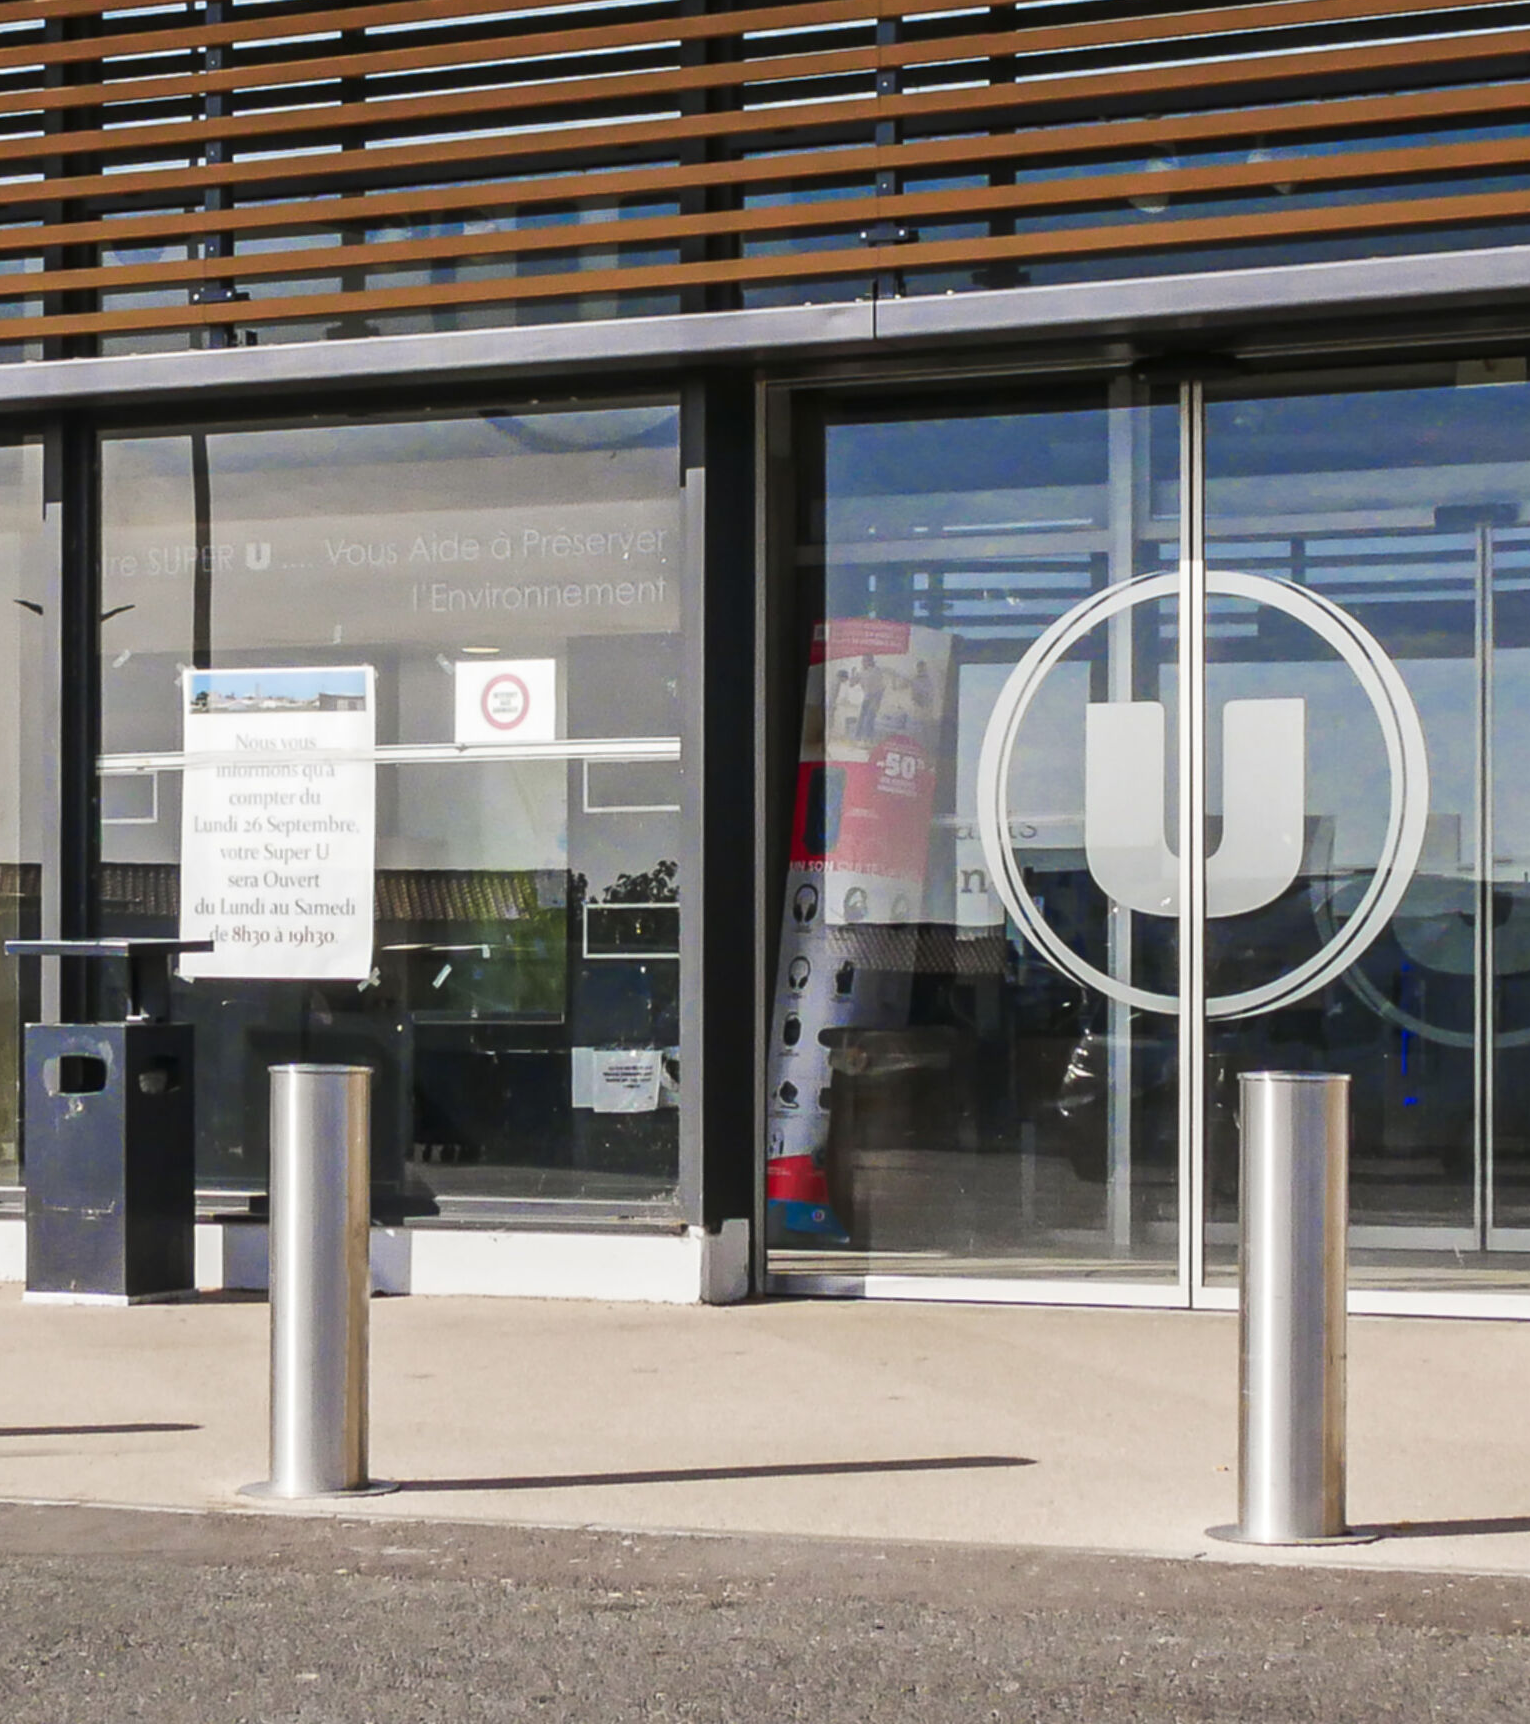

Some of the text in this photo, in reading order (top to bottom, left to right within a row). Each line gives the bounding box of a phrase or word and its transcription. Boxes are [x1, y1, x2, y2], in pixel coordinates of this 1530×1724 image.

[148, 545, 234, 575] SUPER
[245, 542, 271, 570] U
[324, 539, 398, 567] Vous
[409, 534, 479, 562] Aide
[490, 531, 511, 560] à
[523, 526, 667, 557] Préserver
[413, 577, 666, 613] l'Environnement
[235, 733, 317, 750] Nous vous
[216, 762, 298, 778] informons
[228, 787, 321, 810] compter du
[1085, 698, 1305, 918] U
[194, 815, 238, 833] Lundi
[243, 817, 263, 833] 26
[220, 843, 330, 865] votre Super U
[228, 870, 321, 888] sera Ouvert
[194, 897, 356, 916] du Lundi au Samedi
[209, 925, 229, 942] de
[231, 926, 269, 947] 8h30
[274, 927, 283, 943] à
